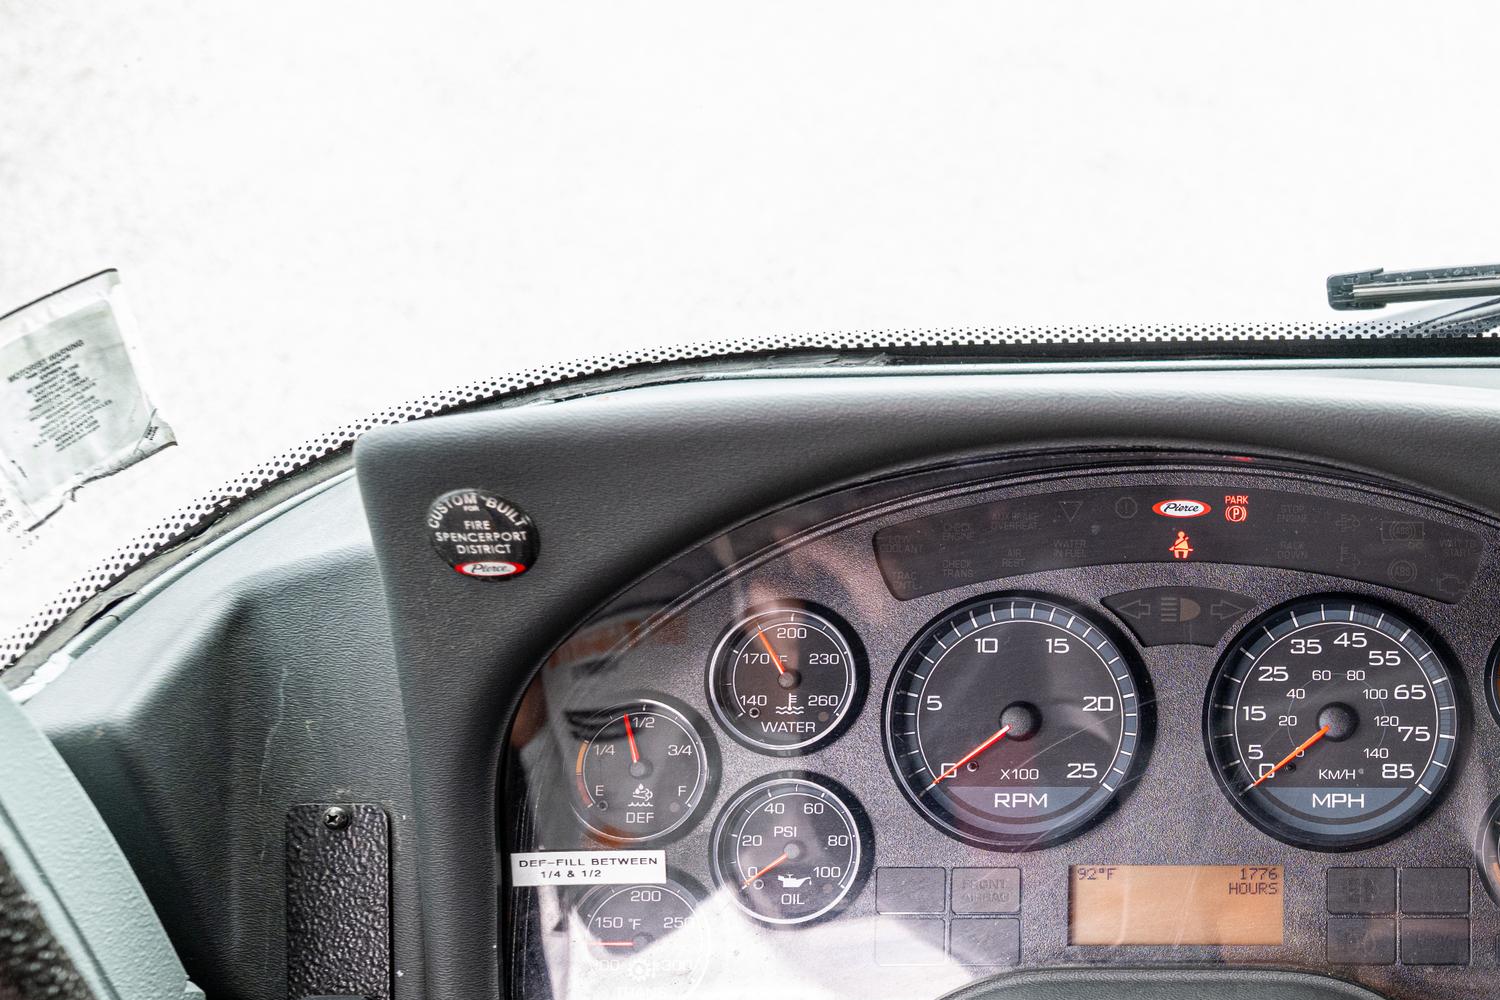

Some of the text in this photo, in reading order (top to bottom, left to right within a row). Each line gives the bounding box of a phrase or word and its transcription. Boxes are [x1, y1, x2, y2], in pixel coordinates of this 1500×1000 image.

[1225, 496, 1248, 504] PARK
[1164, 503, 1199, 512] Pierce
[464, 521, 490, 530] FIRE
[435, 532, 527, 542] SPENCERPORT
[456, 544, 511, 554] DISTRICT
[472, 564, 510, 573] Pierce
[777, 628, 807, 638] 200
[975, 638, 998, 653] 10
[1046, 638, 1069, 653] 15
[1334, 633, 1367, 647] 45
[1291, 639, 1322, 654] 35
[743, 654, 769, 664] 170
[809, 654, 839, 664] 230
[1369, 651, 1400, 665] 55
[1258, 667, 1288, 681] 25
[1312, 670, 1331, 681] 60
[1347, 670, 1365, 681] 80
[1287, 689, 1305, 699] 40
[1363, 689, 1387, 699] 100
[1394, 685, 1426, 699] 65
[740, 695, 767, 706] 140
[808, 695, 838, 706] 260
[927, 696, 943, 711] 5
[1083, 697, 1114, 711] 20
[1243, 706, 1266, 720] 15
[633, 717, 654, 728] 1/2
[1278, 716, 1297, 726] 20
[1374, 716, 1398, 726] 120
[761, 722, 815, 732] WATER
[1398, 727, 1430, 741] 75
[593, 745, 615, 755] 1/4
[668, 745, 692, 755] 3/4
[1364, 748, 1388, 758] 140
[1000, 769, 1039, 780] X100
[1067, 763, 1097, 778] 25
[1319, 769, 1355, 779] KM/H
[1382, 764, 1414, 779] 85
[995, 794, 1048, 808] RPM
[1312, 794, 1364, 808] MPH
[765, 803, 784, 814] 40
[804, 803, 823, 814] 60
[626, 813, 654, 823] DEF
[774, 826, 797, 837] PSI
[742, 835, 762, 846] 20
[828, 836, 847, 846] 80
[519, 859, 585, 868] DEF-FILL
[814, 867, 840, 877] 100
[1240, 868, 1278, 880] 1776
[1229, 883, 1278, 894] HOURS
[631, 891, 661, 901] 200
[782, 894, 804, 904] OIL
